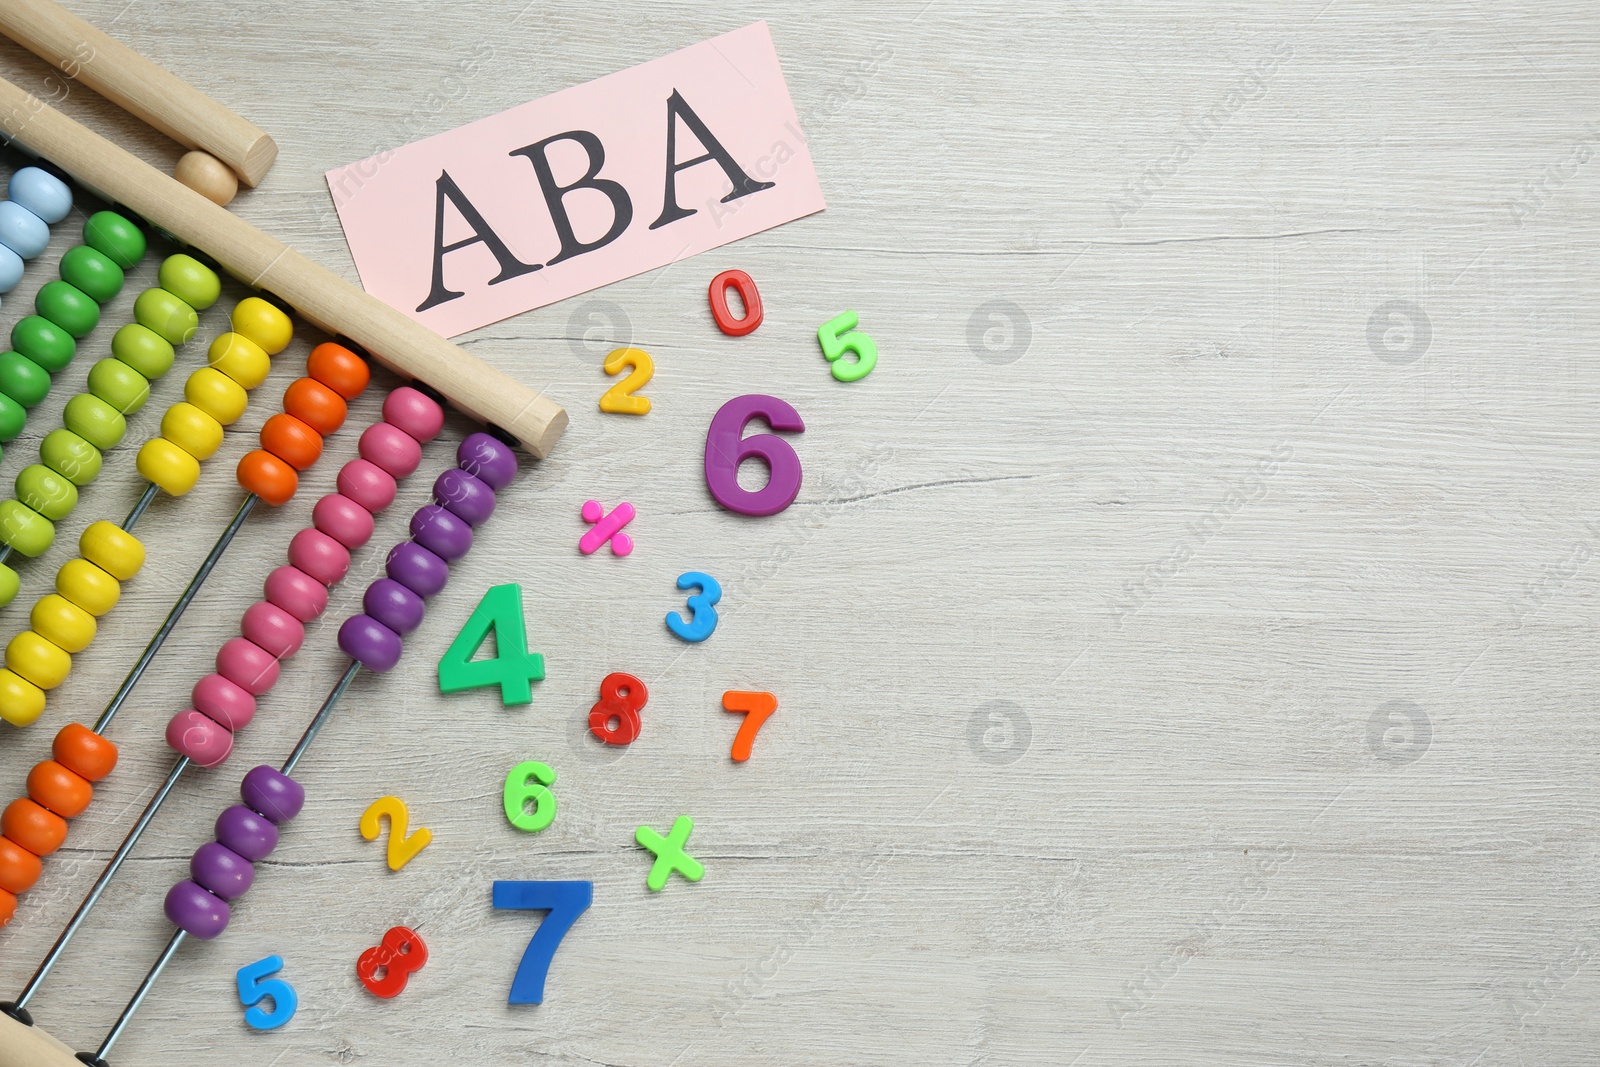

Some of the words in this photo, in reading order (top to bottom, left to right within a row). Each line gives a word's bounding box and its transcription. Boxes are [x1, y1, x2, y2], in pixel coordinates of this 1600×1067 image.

[416, 88, 775, 312] ABA
[599, 348, 654, 415] 2
[817, 310, 877, 382] 5
[704, 395, 805, 516] 6
[666, 572, 722, 643] 3
[438, 584, 545, 706] 4
[588, 673, 647, 745] 8
[722, 691, 778, 763] 7
[503, 761, 556, 832] 6
[359, 796, 433, 872] 2
[356, 926, 428, 999] 8
[492, 881, 592, 1005] 7
[237, 955, 297, 1030] 5
